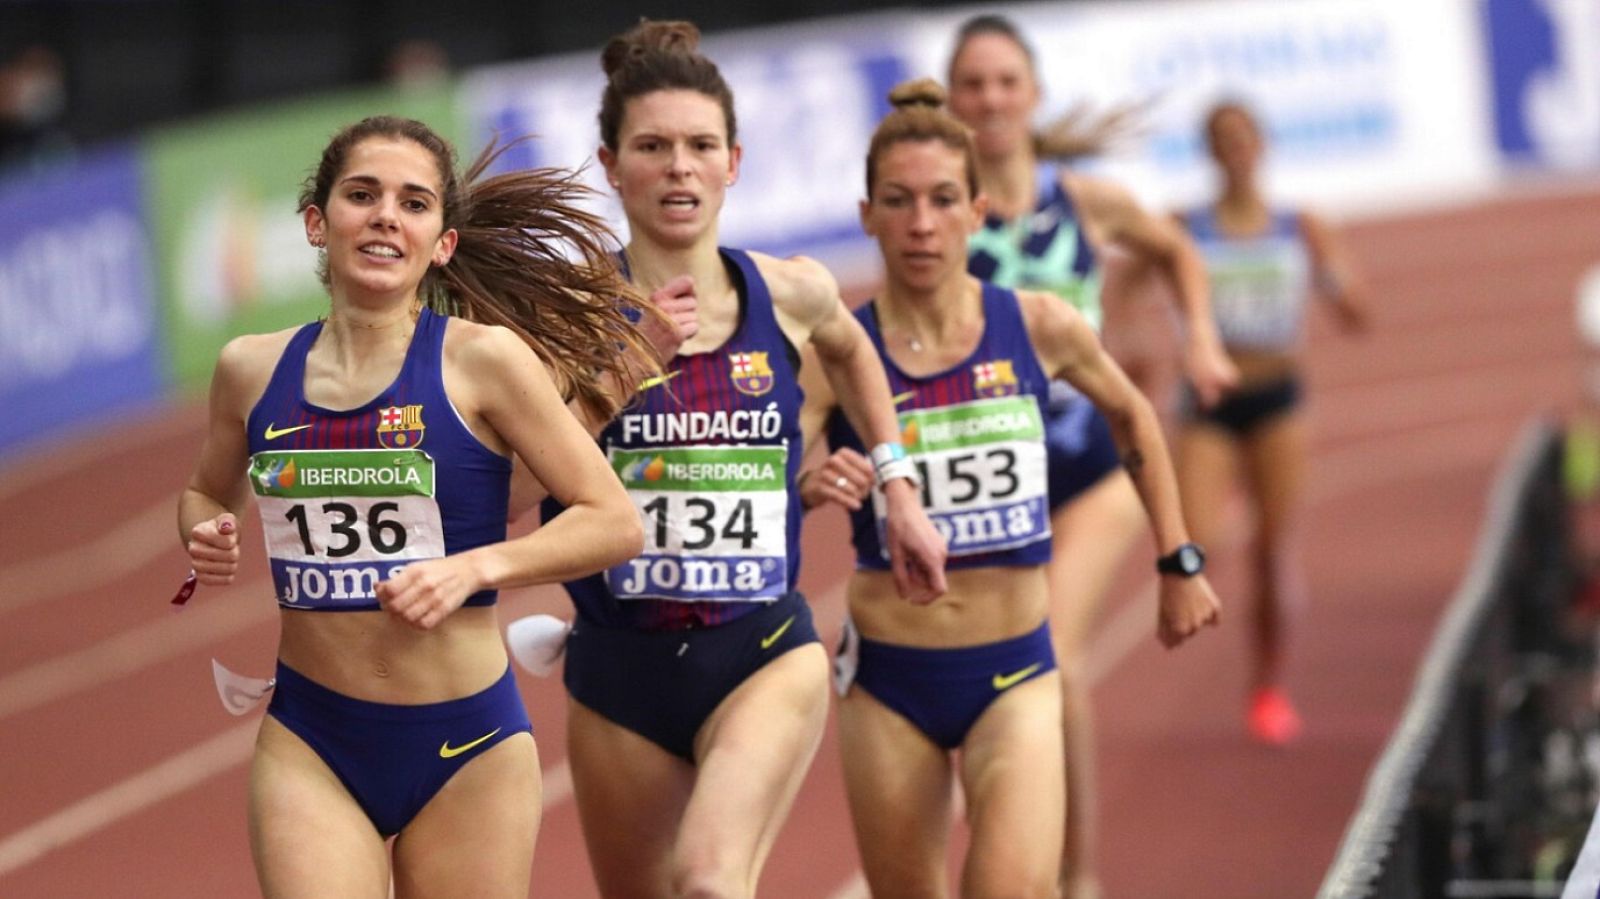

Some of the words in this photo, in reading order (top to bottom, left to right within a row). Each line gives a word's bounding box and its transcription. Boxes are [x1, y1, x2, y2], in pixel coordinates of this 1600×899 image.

[623, 402, 782, 443] FUNDACIÓ
[300, 467, 421, 486] IBERDROLA
[667, 462, 776, 481] IBERDROLA
[915, 448, 1019, 508] 153
[285, 501, 407, 558] 136
[643, 496, 758, 550] 134
